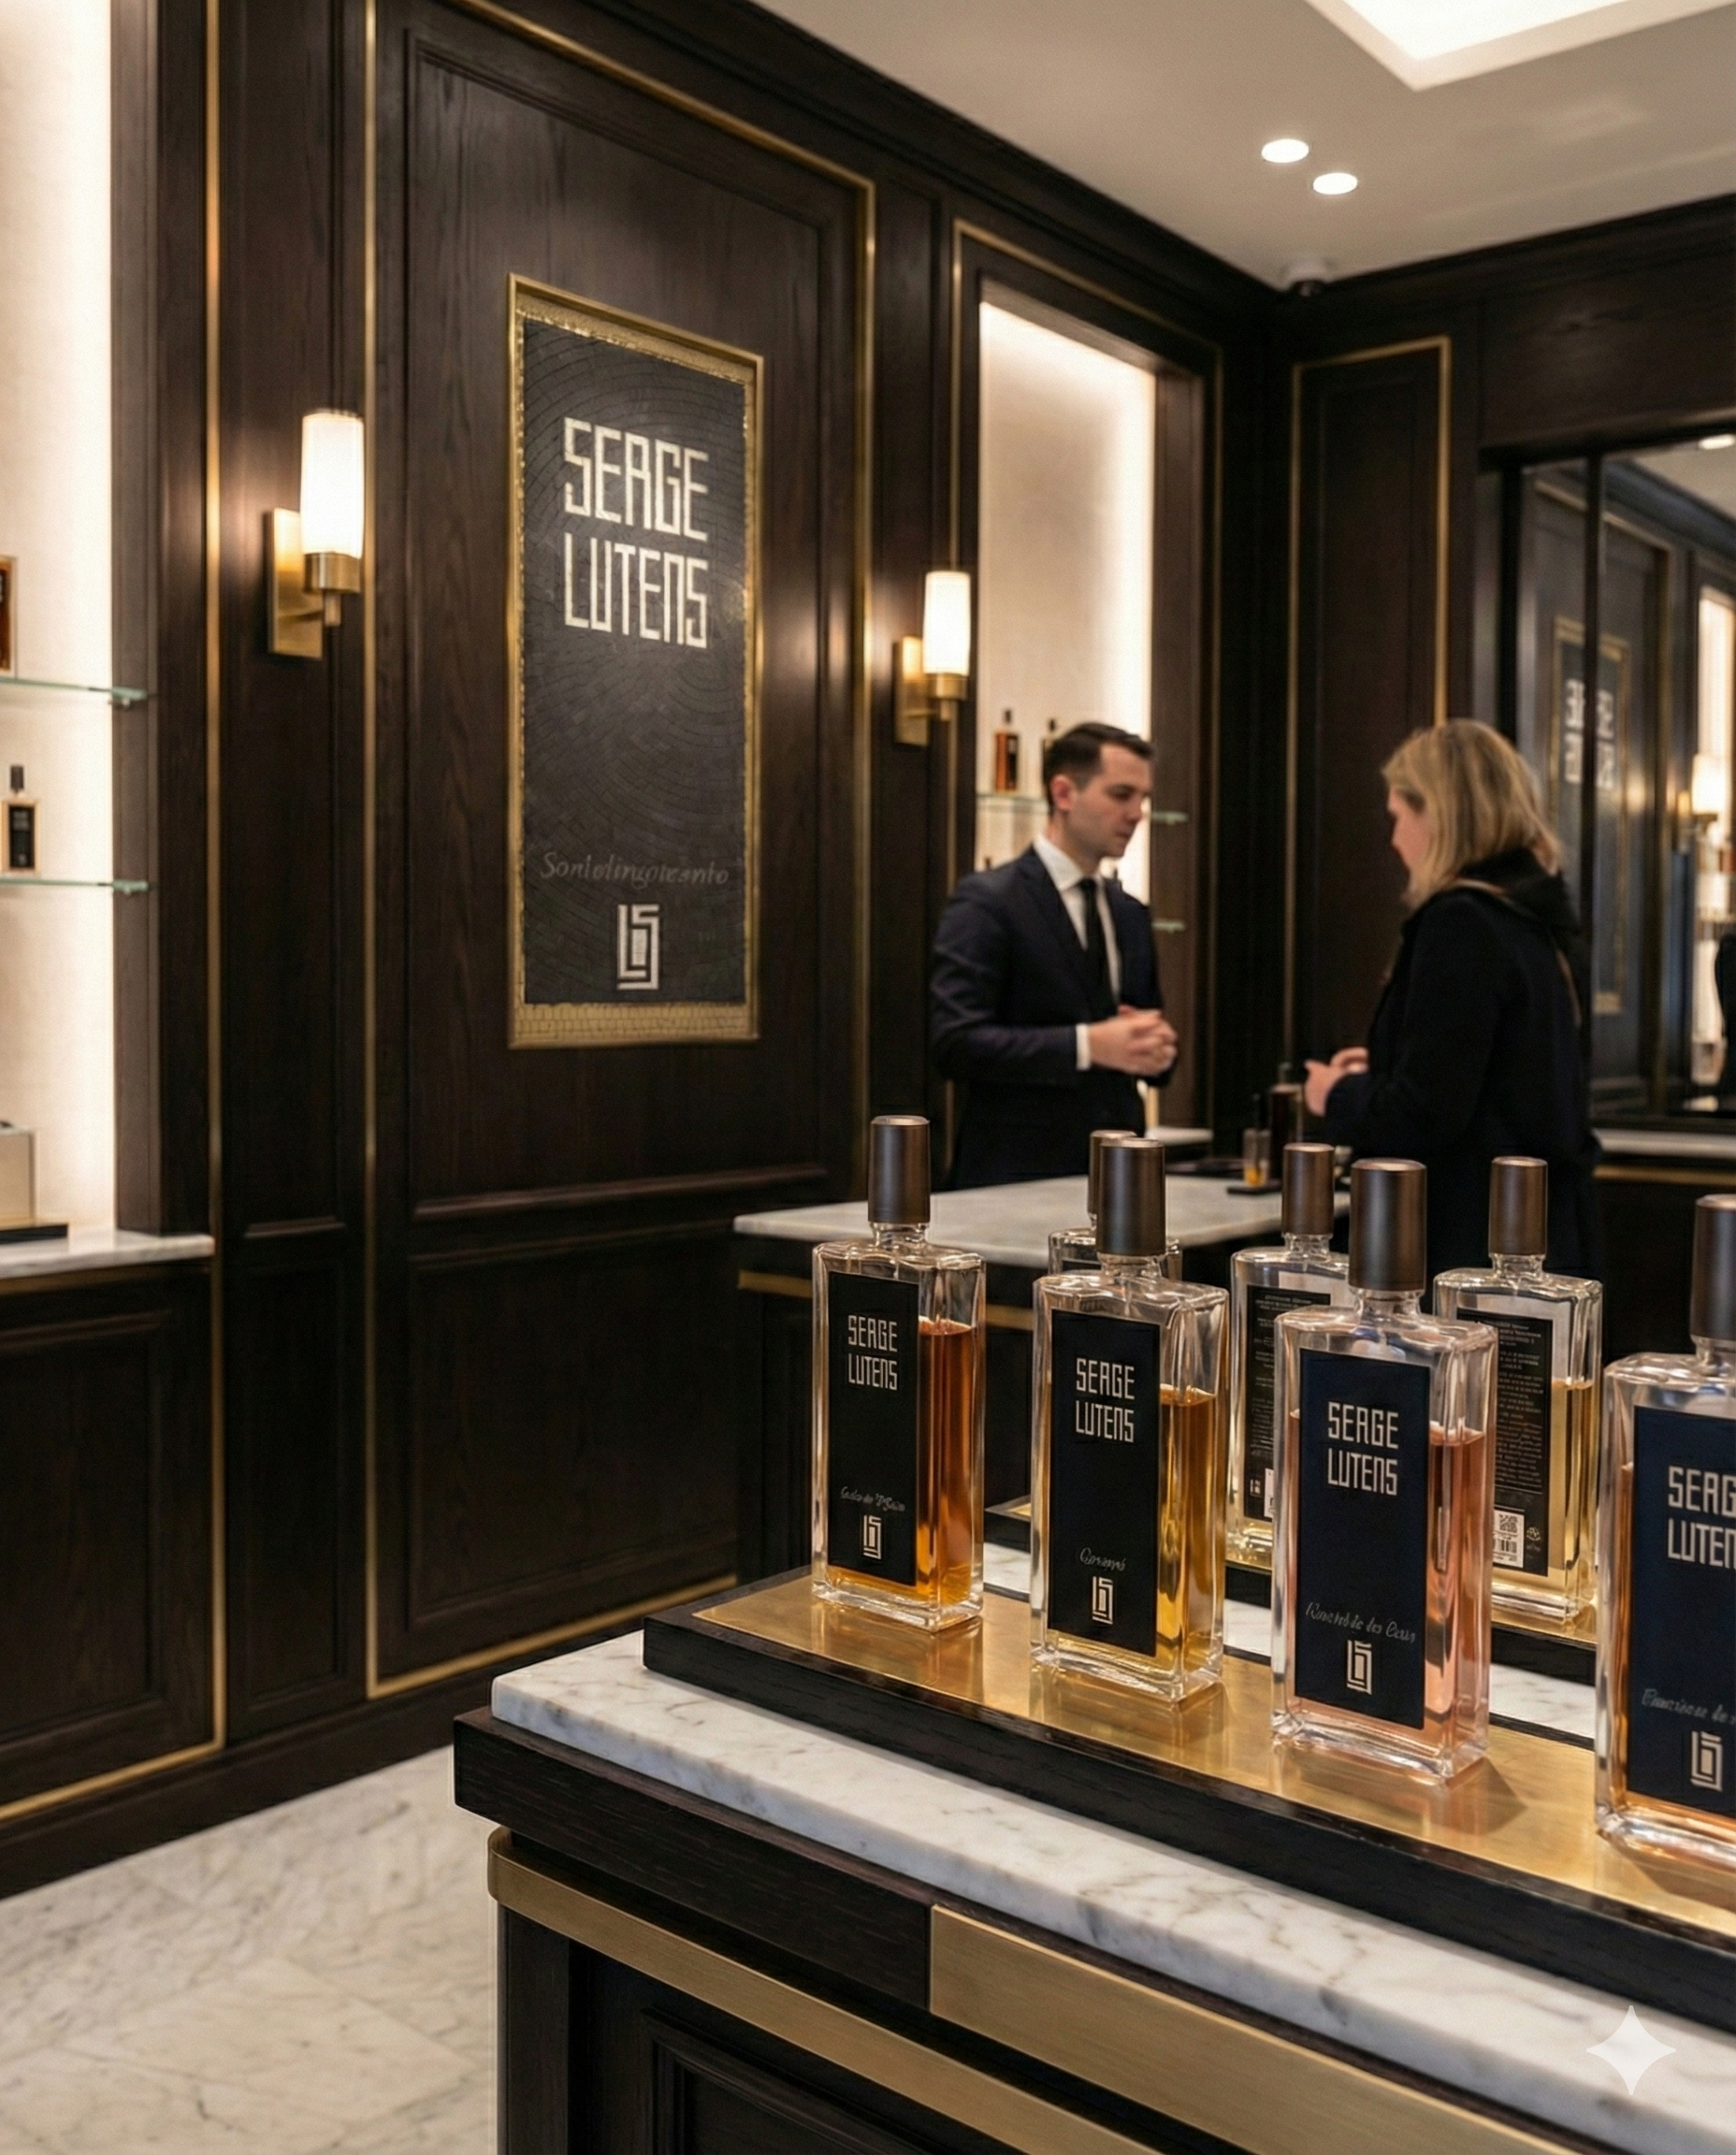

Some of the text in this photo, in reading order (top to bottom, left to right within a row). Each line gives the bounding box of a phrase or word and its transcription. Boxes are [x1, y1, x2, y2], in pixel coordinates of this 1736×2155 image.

[564, 417, 708, 542] SERGE
[564, 532, 708, 649] LUTENS
[847, 1314, 898, 1352] SERGE
[848, 1352, 898, 1391] LUTENS
[1076, 1357, 1136, 1400] SERGE
[1076, 1400, 1135, 1443] LUTENS
[1327, 1401, 1399, 1450] SERGE
[1327, 1447, 1398, 1496] LUTENS
